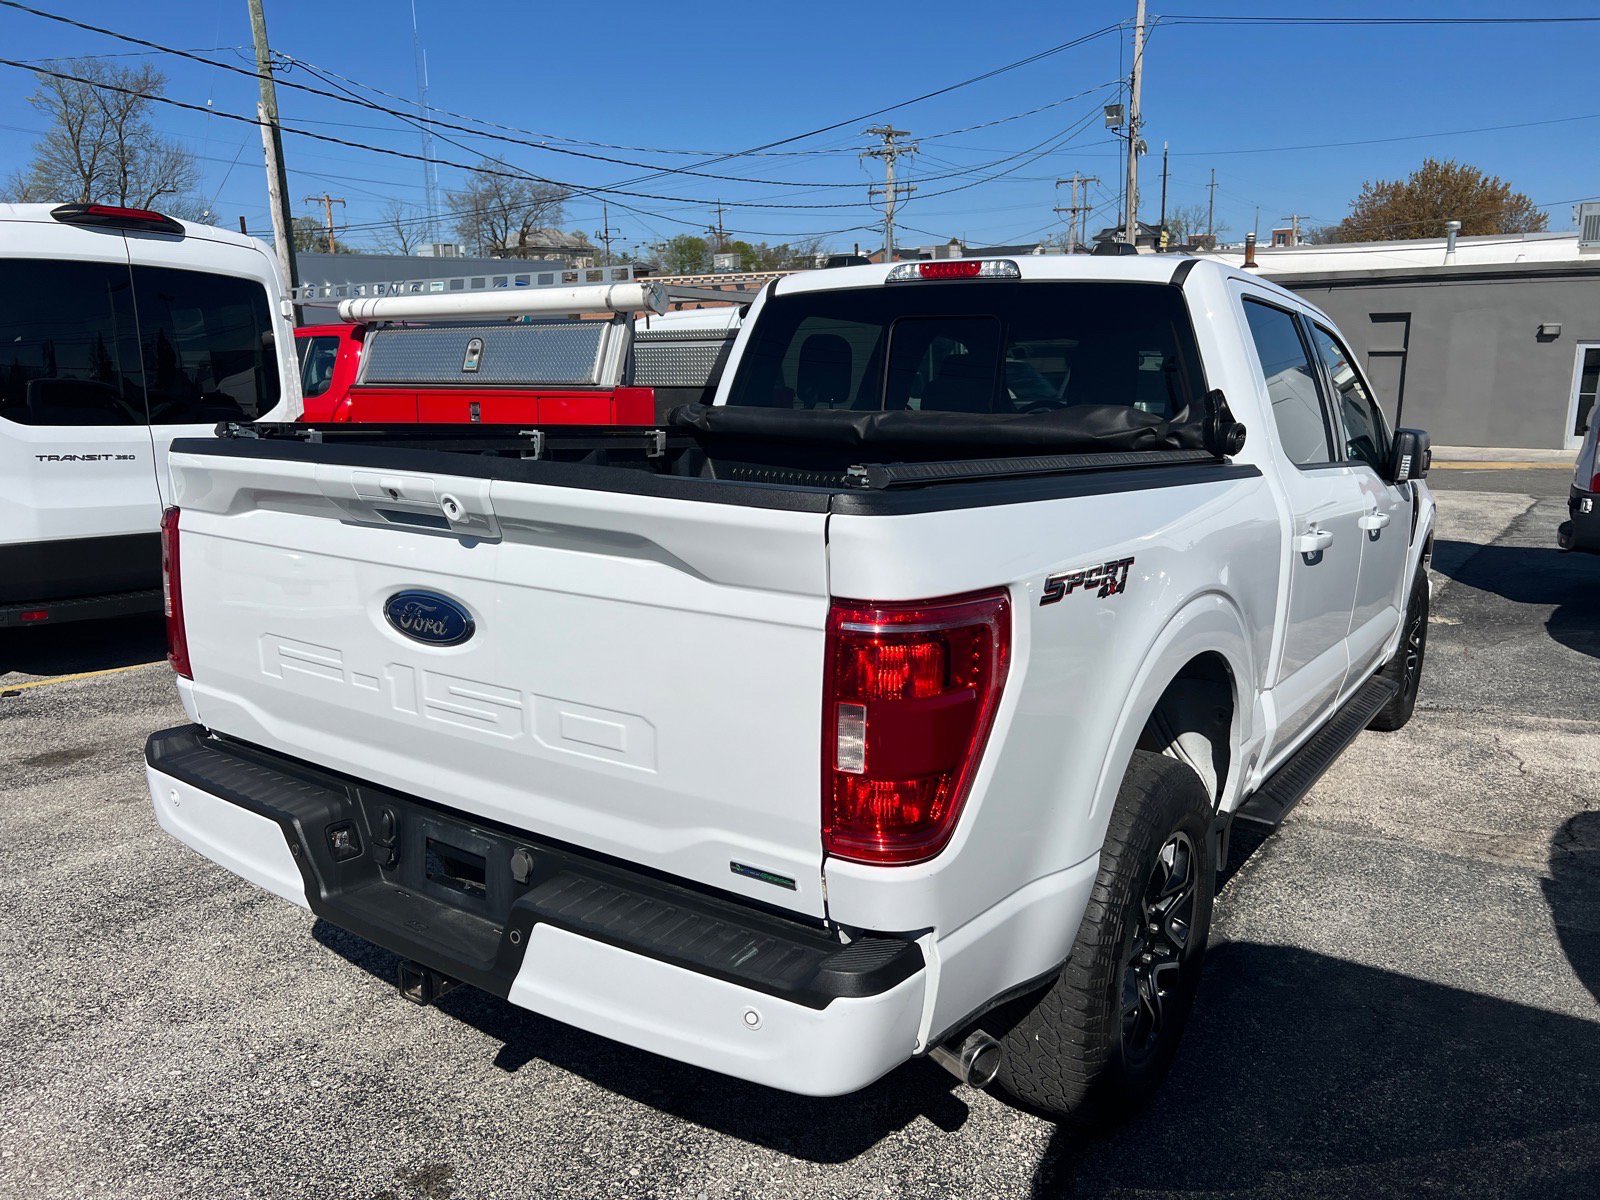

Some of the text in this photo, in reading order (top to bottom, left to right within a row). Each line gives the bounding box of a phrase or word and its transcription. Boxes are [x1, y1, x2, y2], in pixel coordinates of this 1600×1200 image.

[35, 454, 114, 462] TRANSIT
[1039, 556, 1135, 606] SPORT
[400, 601, 449, 636] Ford
[258, 632, 659, 775] F-150
